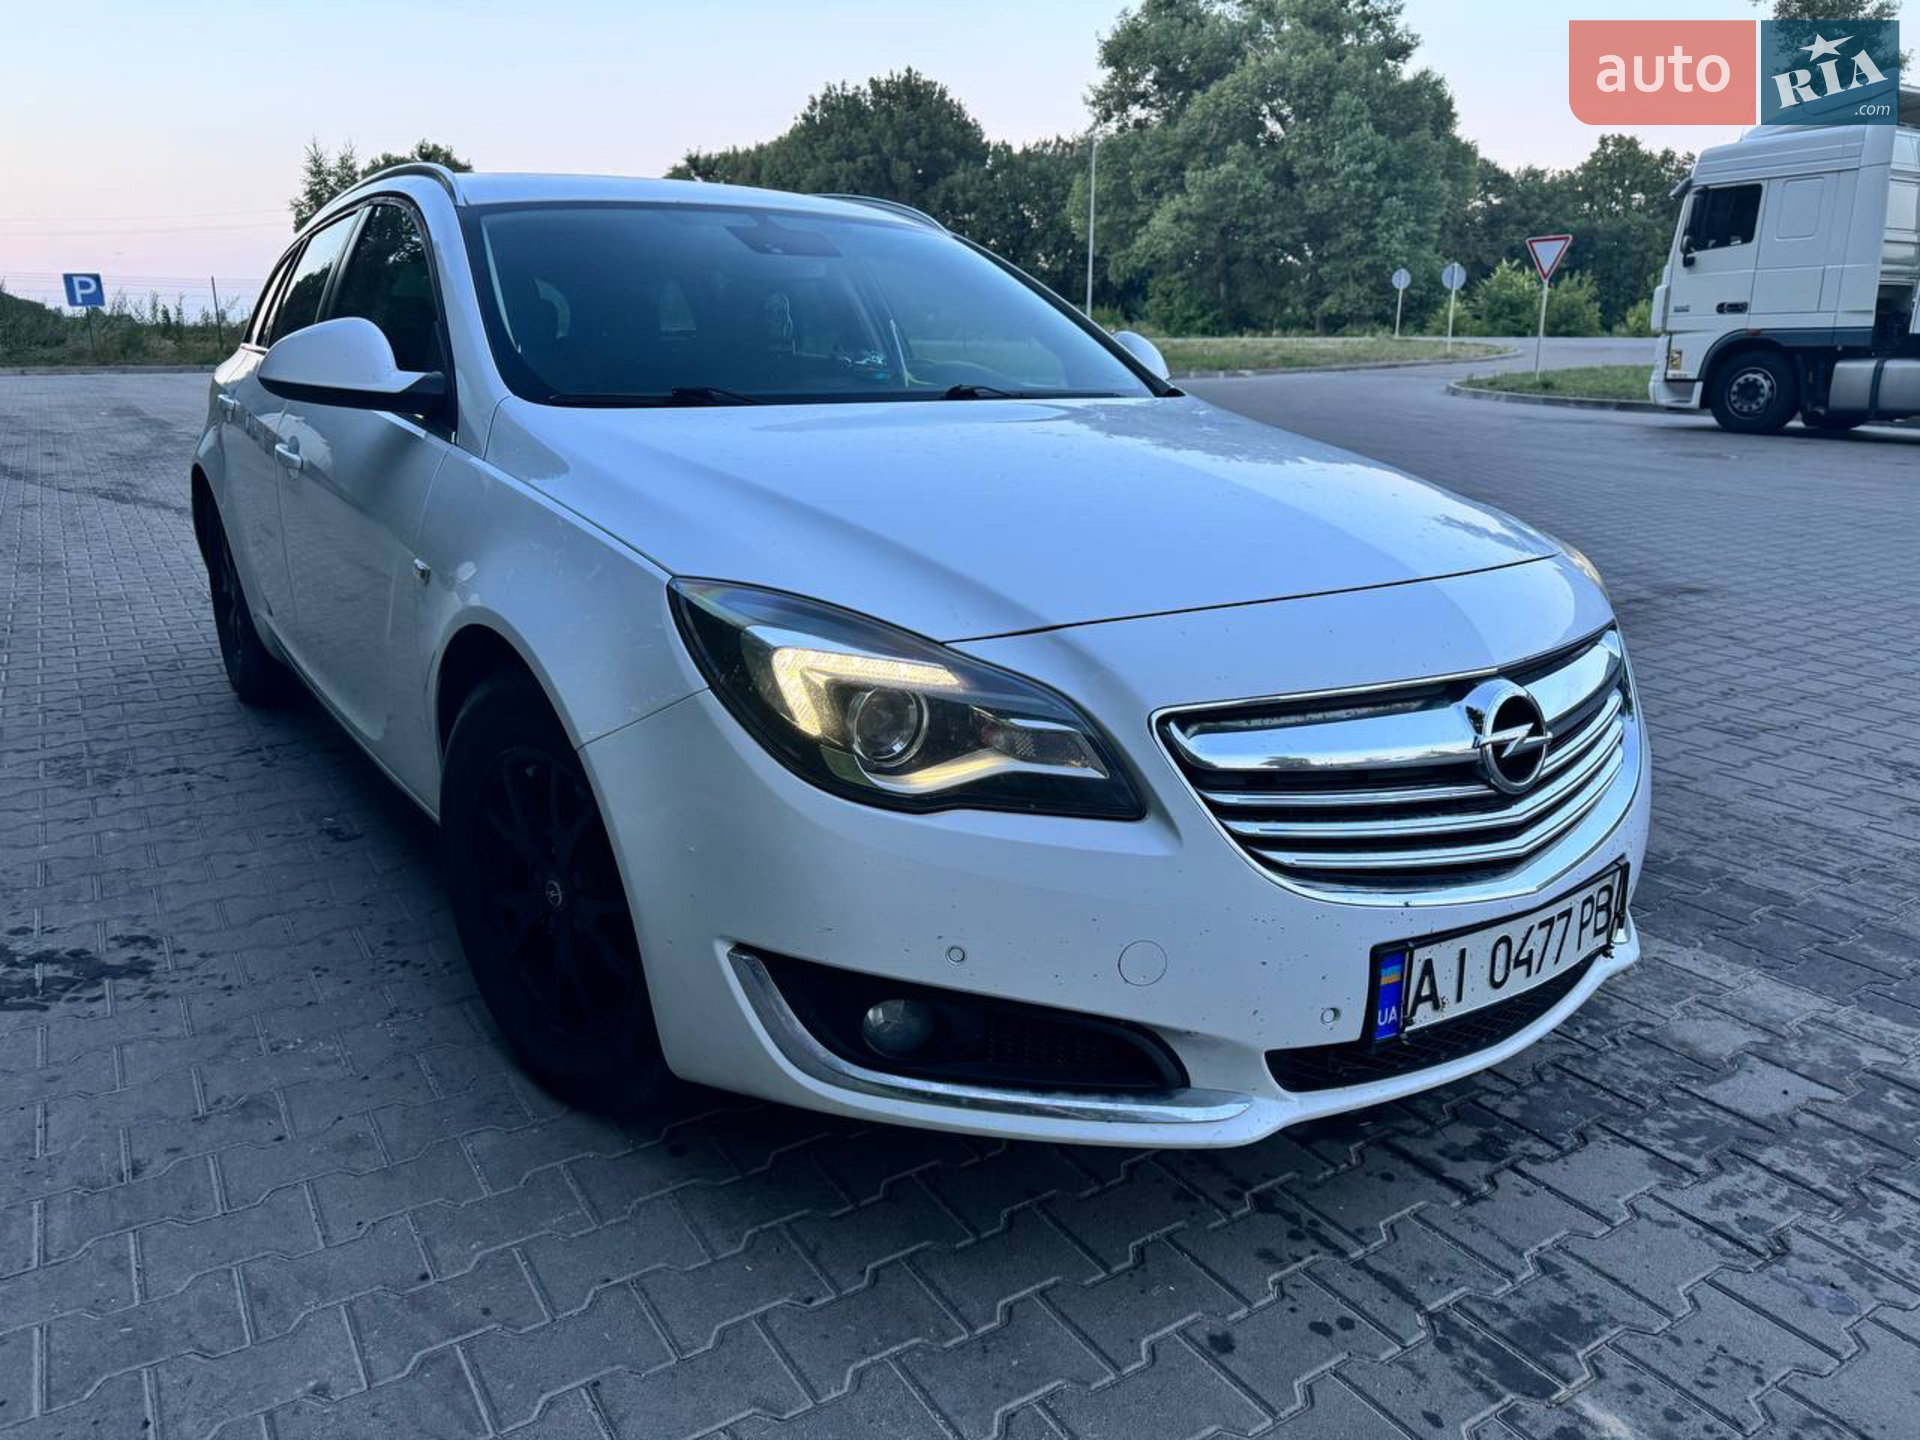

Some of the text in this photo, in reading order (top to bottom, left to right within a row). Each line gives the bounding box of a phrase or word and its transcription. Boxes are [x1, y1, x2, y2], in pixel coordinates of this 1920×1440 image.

[72, 275, 96, 304] P
[1408, 884, 1614, 1018] AI 0477 PB
[1377, 1005, 1398, 1026] UA
